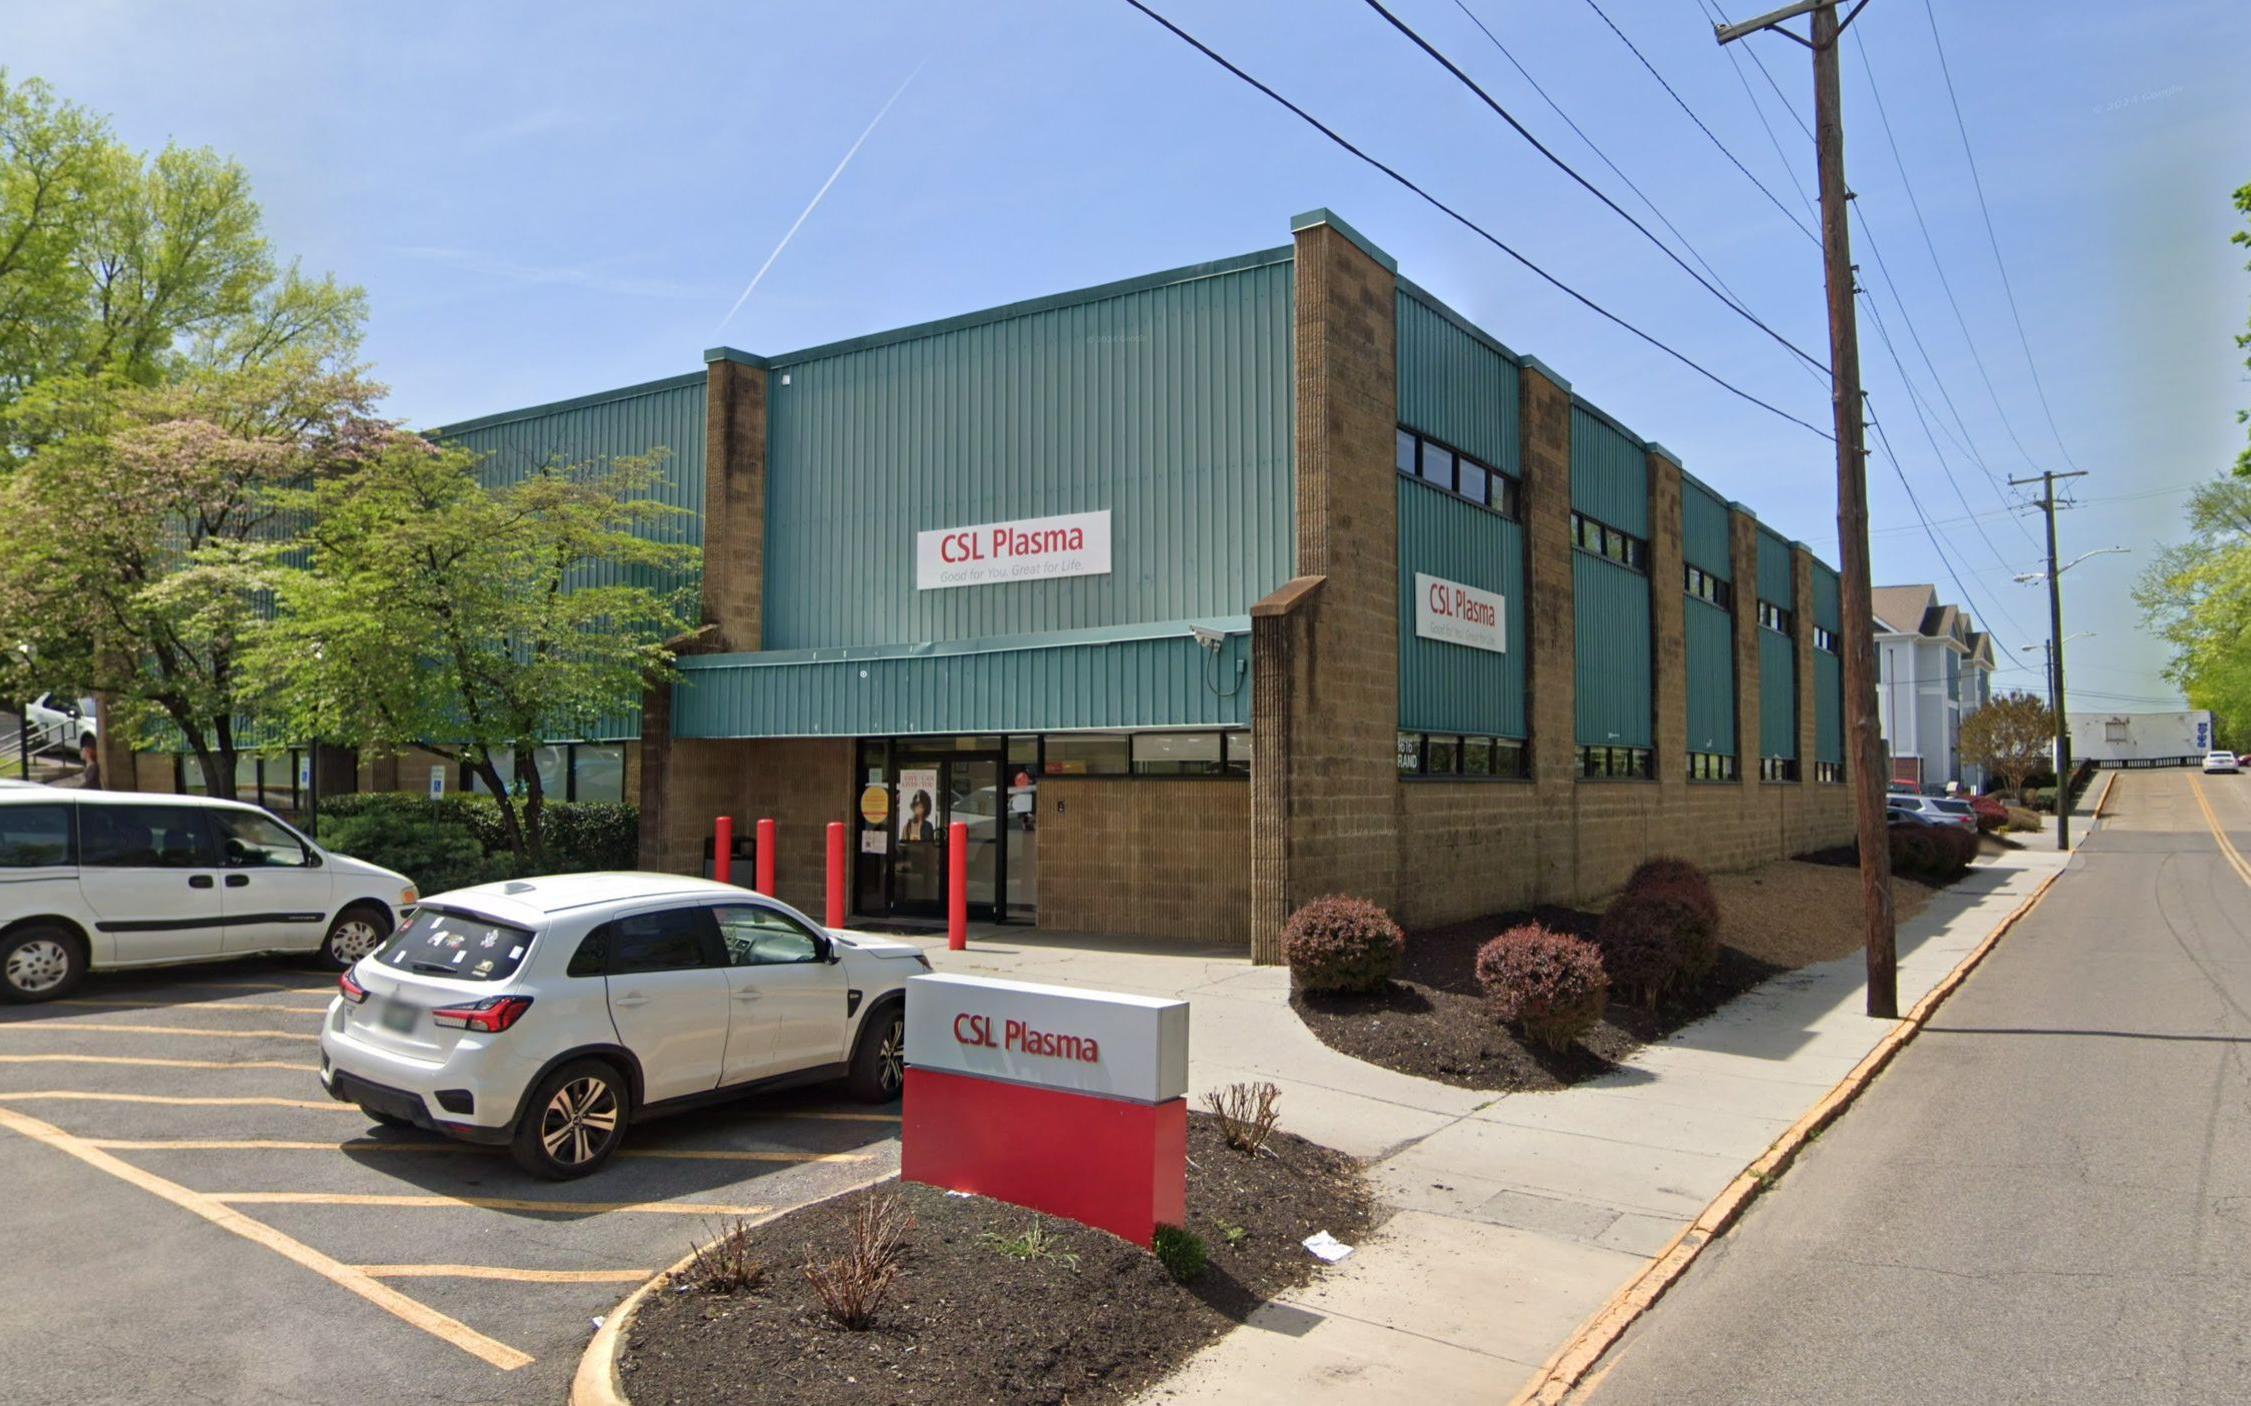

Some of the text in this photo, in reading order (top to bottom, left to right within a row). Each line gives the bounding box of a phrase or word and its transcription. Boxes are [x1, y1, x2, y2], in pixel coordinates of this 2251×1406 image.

[940, 527, 1084, 564] CSL Plasma
[940, 569, 967, 583] Good
[969, 567, 984, 580] for
[1011, 562, 1041, 576] Great
[1043, 561, 1058, 573] for
[1430, 583, 1495, 626] CSL Plasma
[953, 1013, 1099, 1063] CSL Plasma
